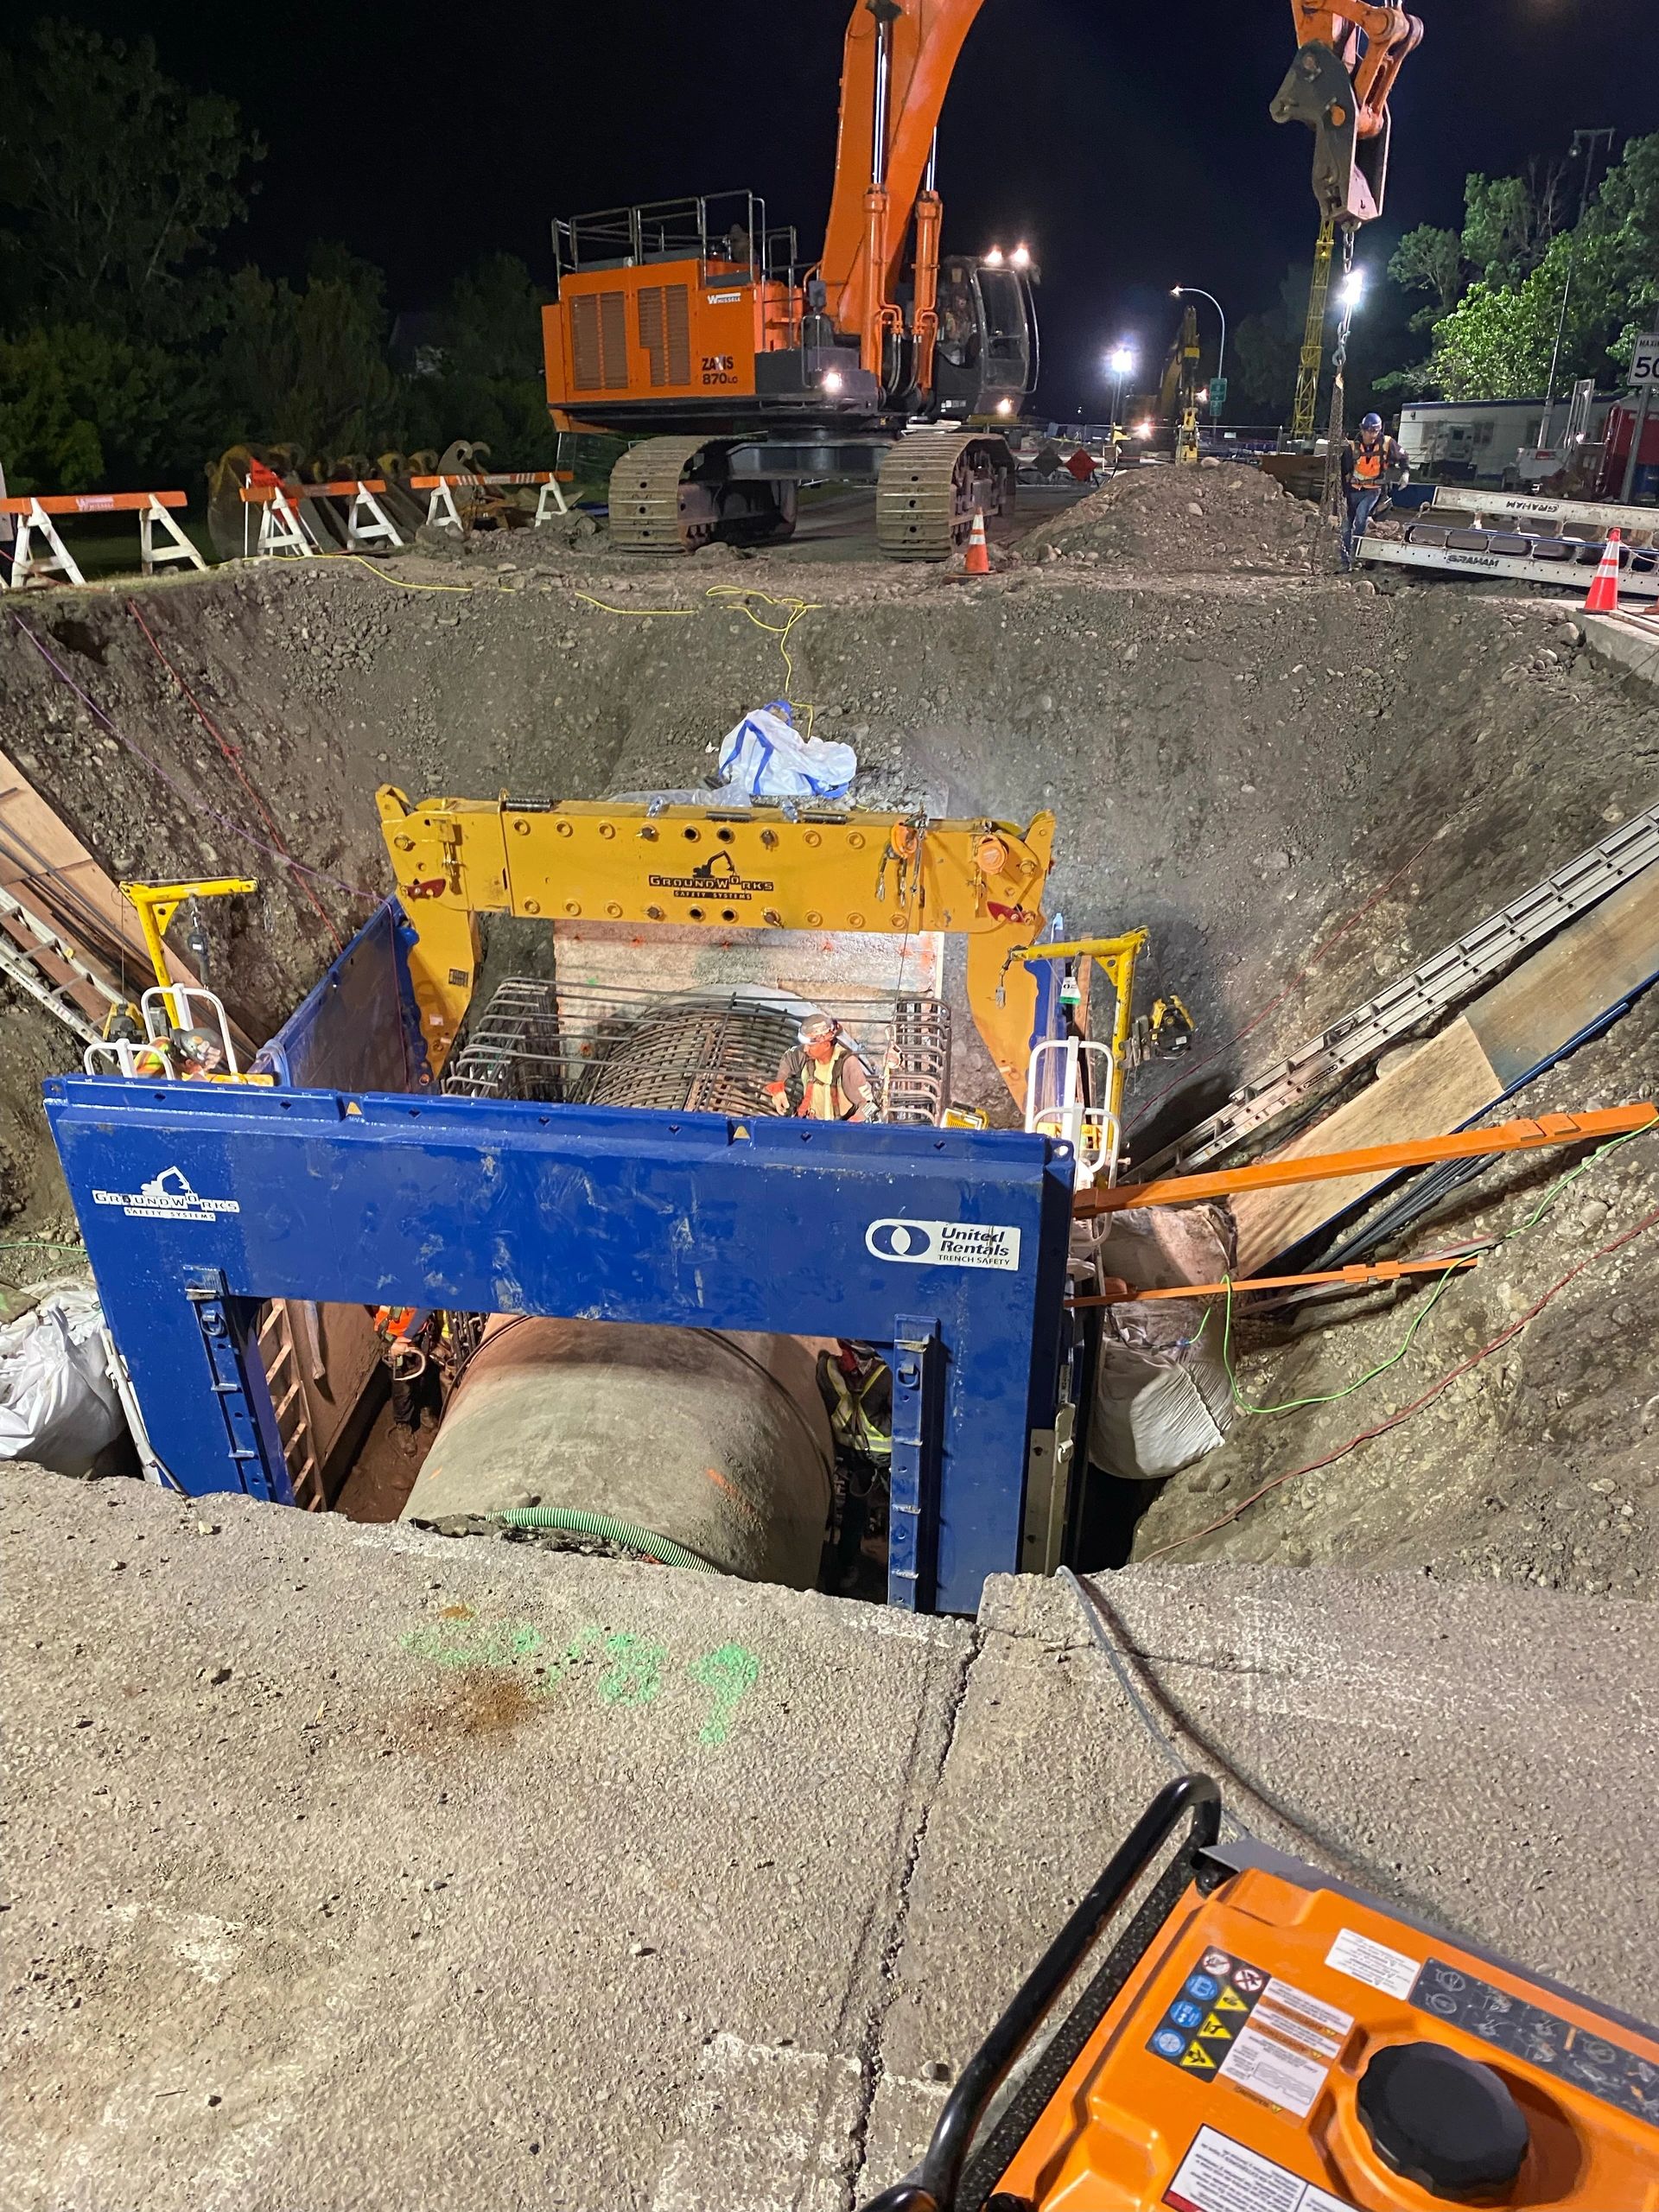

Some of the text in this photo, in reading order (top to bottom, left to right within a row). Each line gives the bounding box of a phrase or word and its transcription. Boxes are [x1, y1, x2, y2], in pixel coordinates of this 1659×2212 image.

[1506, 500, 1559, 513] GRAHAM
[1447, 555, 1499, 568] GRAHAM
[126, 1208, 214, 1220] SAFETY SYSTEMS
[941, 1227, 1005, 1243] United
[940, 1240, 1009, 1256] Rentals
[938, 1254, 1010, 1265] TRENCH SAFETY
